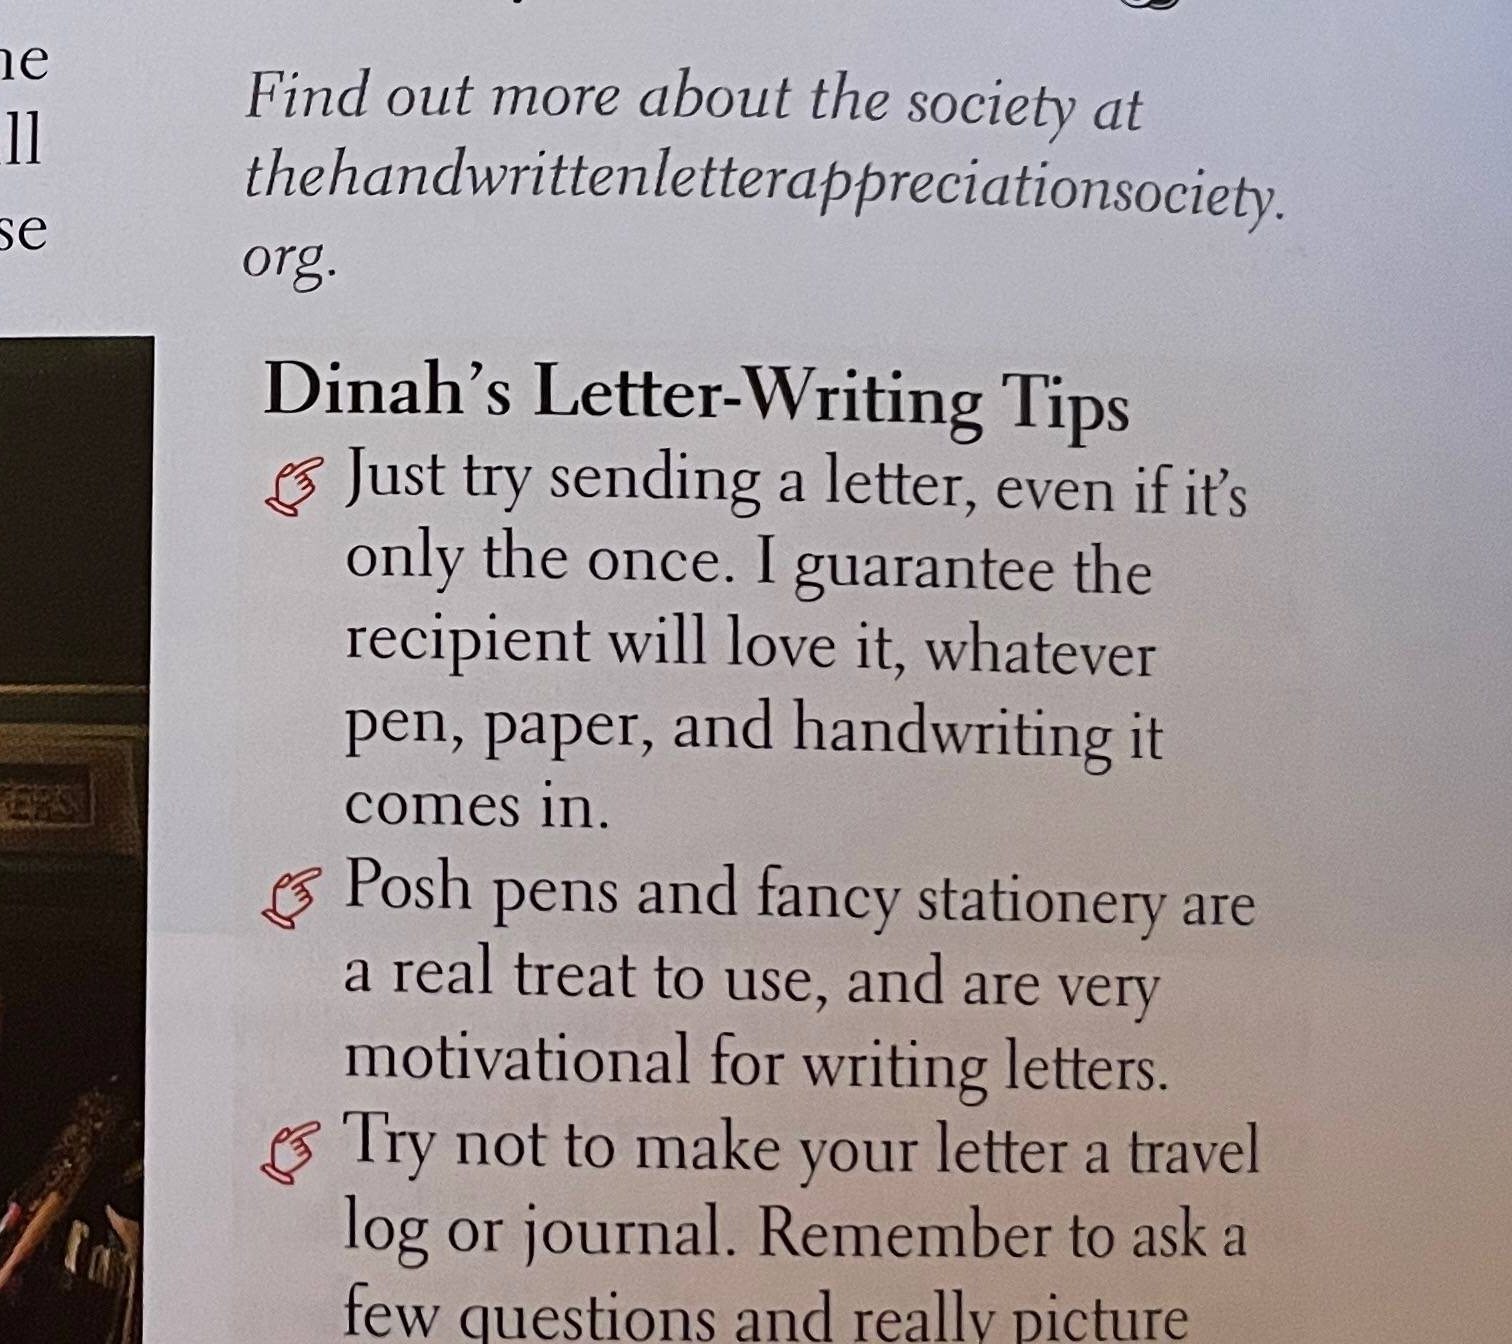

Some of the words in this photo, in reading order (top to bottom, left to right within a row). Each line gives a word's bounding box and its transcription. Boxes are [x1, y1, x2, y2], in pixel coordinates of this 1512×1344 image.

[245, 66, 372, 118] Find
[386, 74, 475, 117] out
[492, 85, 621, 117] more
[639, 66, 793, 120] about
[811, 69, 890, 122] the
[907, 78, 1077, 145] society
[1093, 90, 1144, 132] at
[246, 145, 1284, 235] thehandwrittenletterappreciationsociety.
[242, 243, 336, 294] org.
[263, 357, 511, 416] Dinah’s
[533, 361, 984, 446] Letter-Writing
[1001, 372, 1130, 449] Tips
[346, 525, 465, 594] only
[482, 526, 568, 580] the
[588, 548, 734, 583] once.
[756, 533, 776, 584] I
[794, 547, 1055, 603] guarantee
[1073, 541, 1152, 596] the
[346, 611, 592, 678] recipient
[607, 611, 707, 665] will
[726, 613, 836, 669] love
[856, 620, 906, 682] it,
[924, 619, 1157, 677] whatever
[344, 1029, 691, 1085] motivational
[710, 1031, 786, 1086] for
[801, 1038, 989, 1108] writing
[1004, 1036, 1168, 1092] letters.
[343, 1281, 441, 1339] few
[735, 1288, 834, 1343] and
